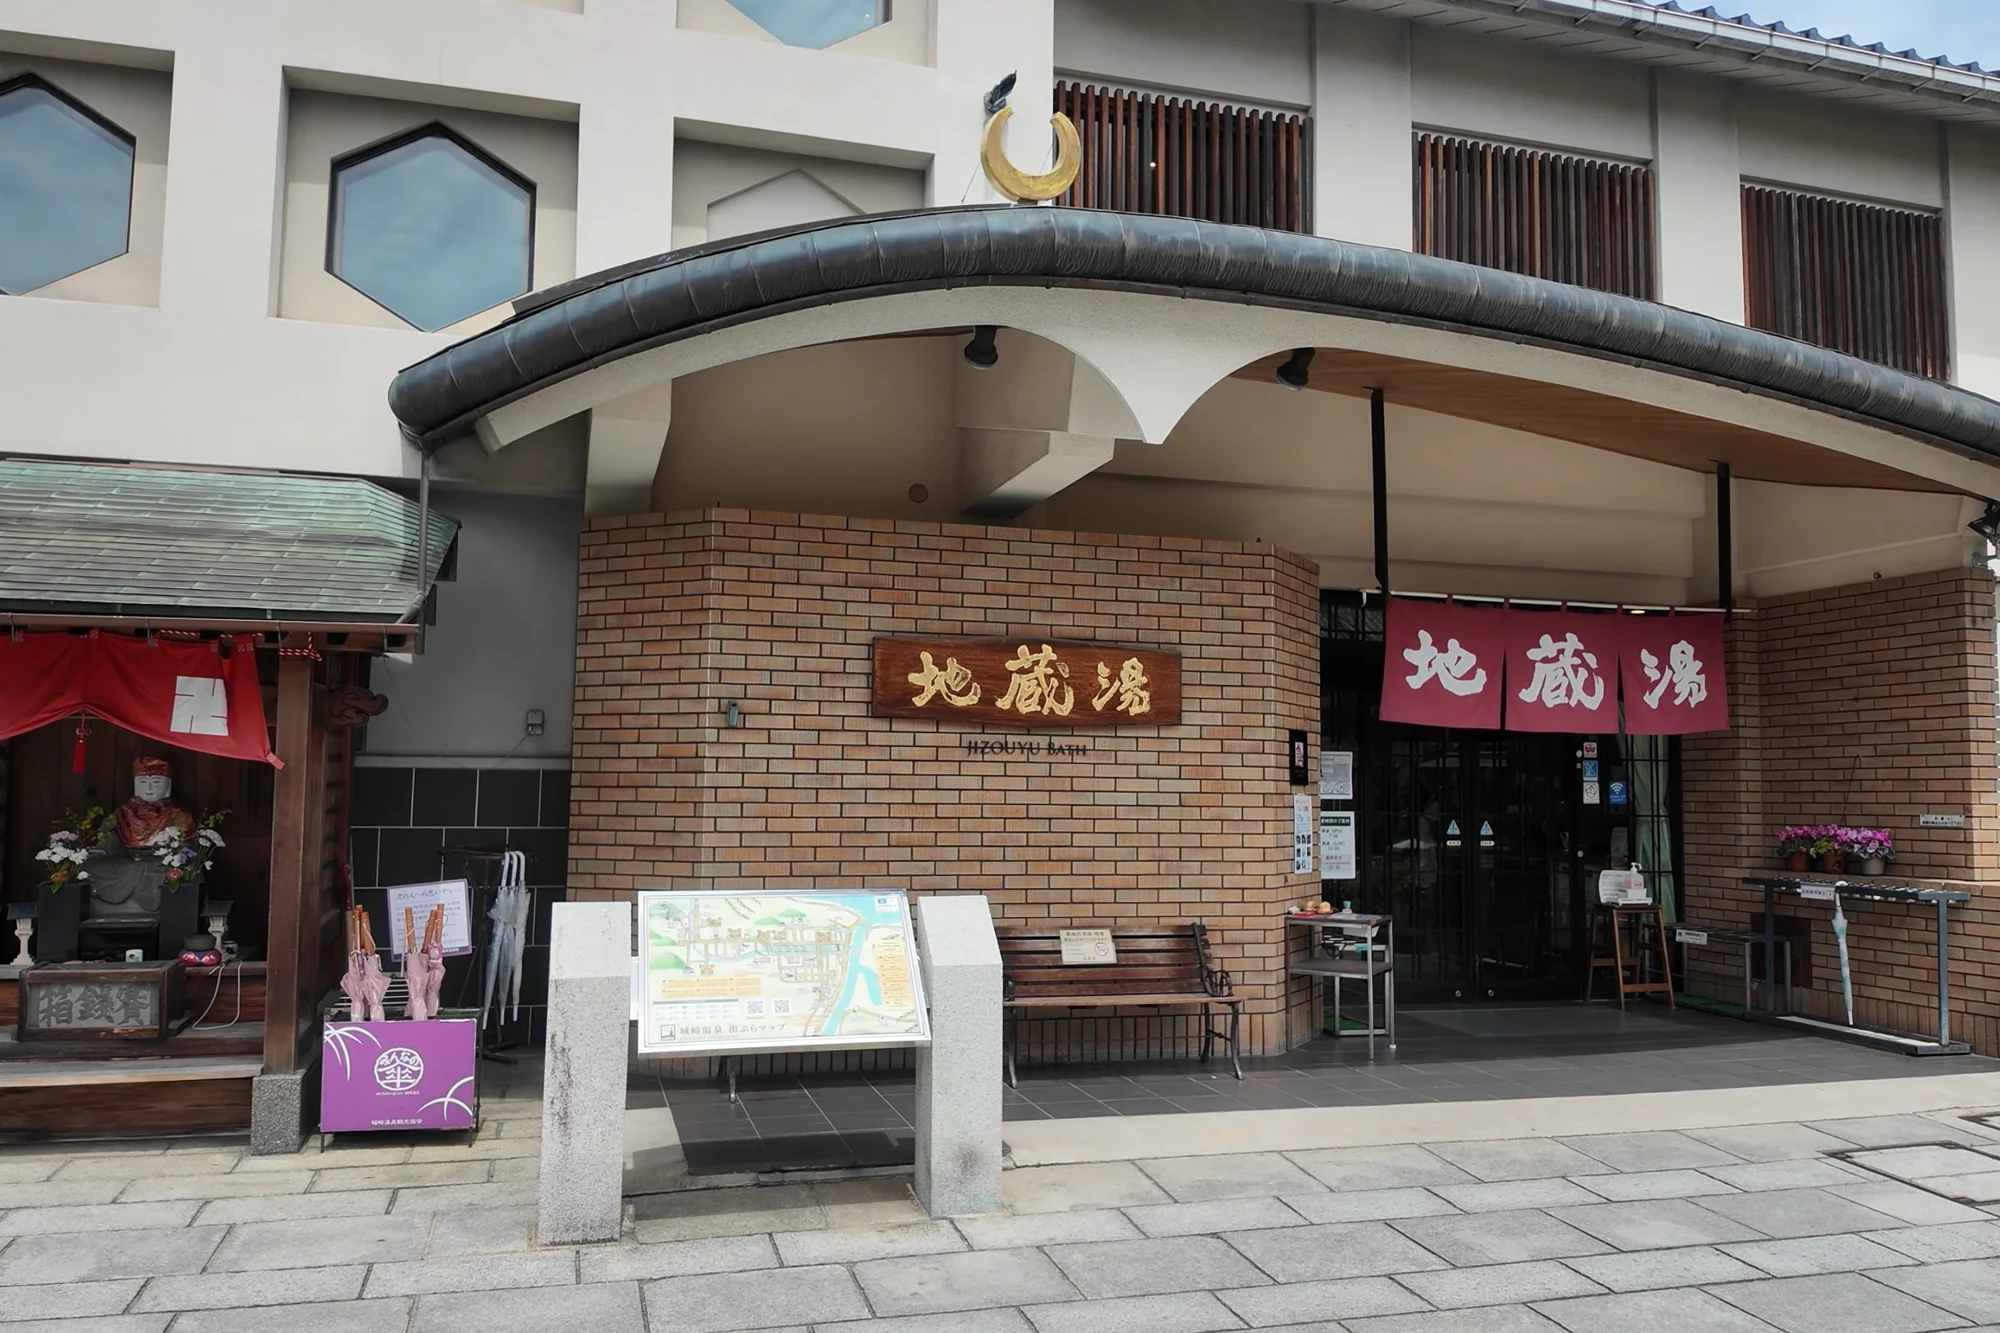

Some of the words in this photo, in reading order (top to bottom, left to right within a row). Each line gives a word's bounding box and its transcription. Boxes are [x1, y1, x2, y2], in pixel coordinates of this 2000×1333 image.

[908, 644, 1152, 716] 地蔵湯
[1403, 629, 1707, 711] 地蔵湯
[966, 739, 1041, 756] JIZOUYU
[1047, 740, 1087, 756] BATH
